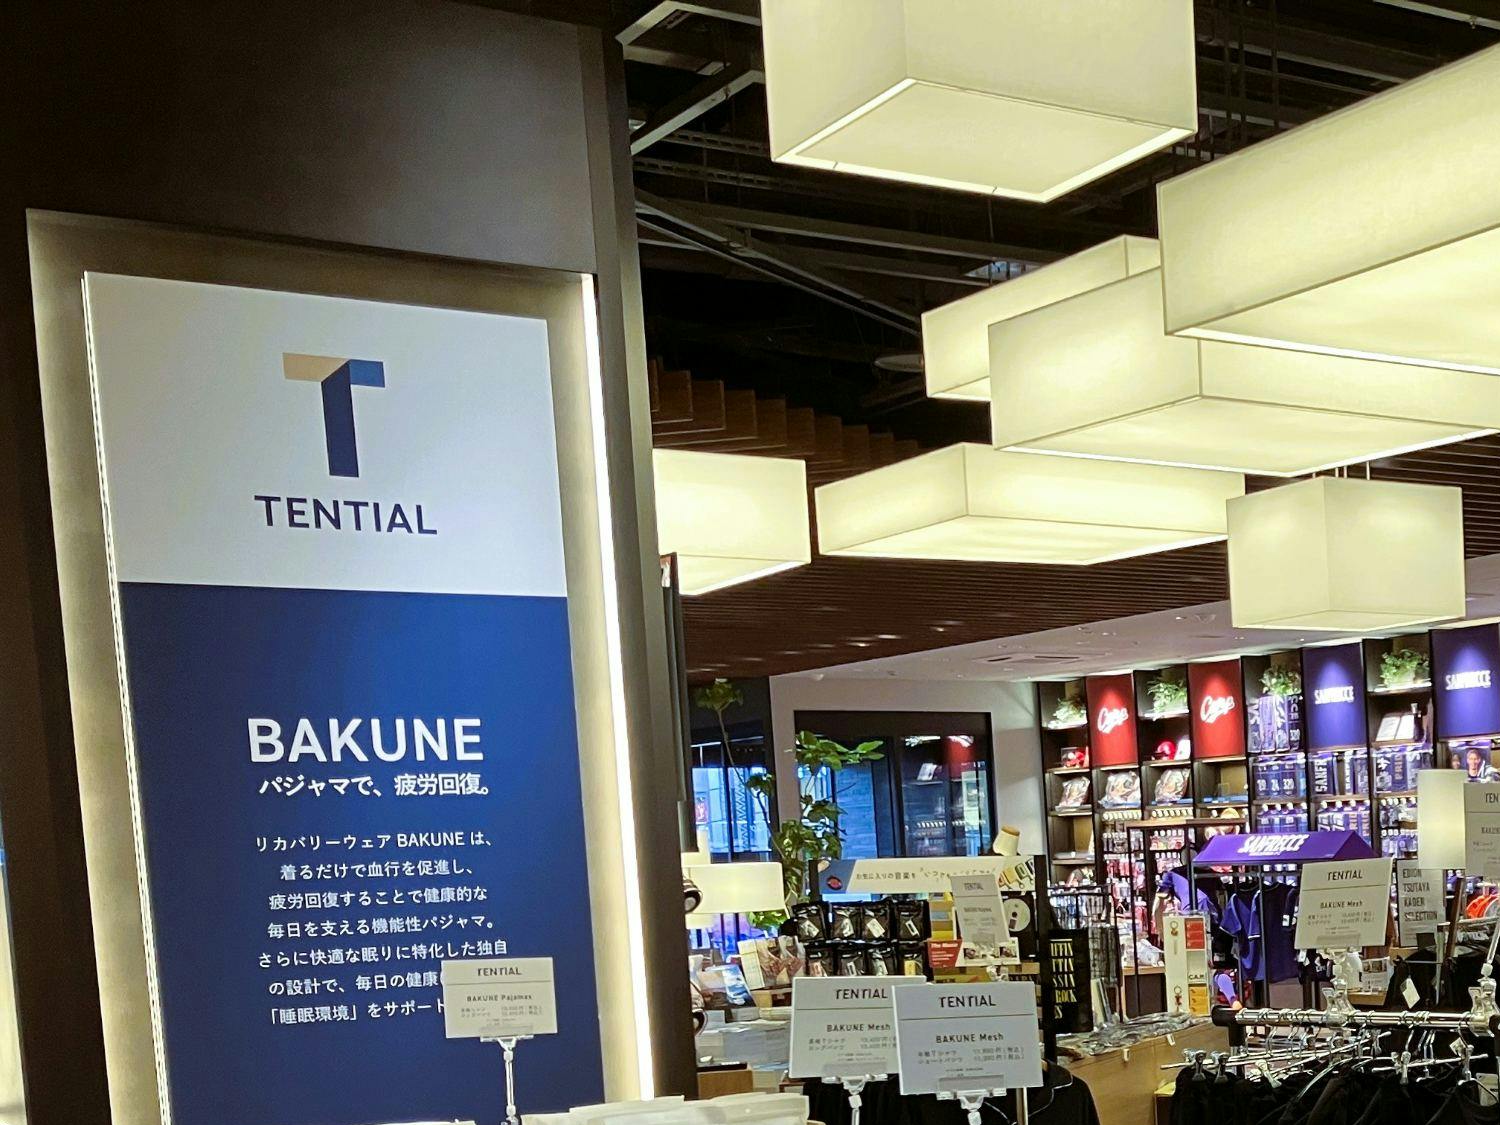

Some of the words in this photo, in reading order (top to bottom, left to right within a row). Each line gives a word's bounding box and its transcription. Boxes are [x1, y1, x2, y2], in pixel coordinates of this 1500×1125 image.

[253, 494, 438, 536] TENTIAL
[247, 717, 485, 763] BAKUNE
[258, 772, 492, 798] パジャマで、疲労回復。
[255, 834, 391, 852] リカバリーウェア
[397, 832, 465, 848] BAKUNE
[470, 831, 493, 846] は、
[279, 859, 474, 881] 着るだけで血行を促進し、
[1327, 870, 1364, 881] TENTIAL
[268, 885, 488, 910] 疲労回復することで健康的な
[1402, 882, 1430, 893] TSUTAYA
[266, 914, 496, 940] 毎日を支える機能性パジャマ。
[257, 939, 508, 967] さらに快適な眠りに特化した独自
[477, 966, 523, 977] TENTIAL
[268, 971, 447, 996] の設計で、毎日の健康
[834, 988, 889, 1000] TENTIAL
[938, 994, 998, 1009] TENTIAL
[826, 1023, 864, 1032] BAKUNE
[867, 1023, 891, 1031] Mesh
[935, 1034, 976, 1044] BAKUNE
[979, 1032, 1004, 1042] Mesh
